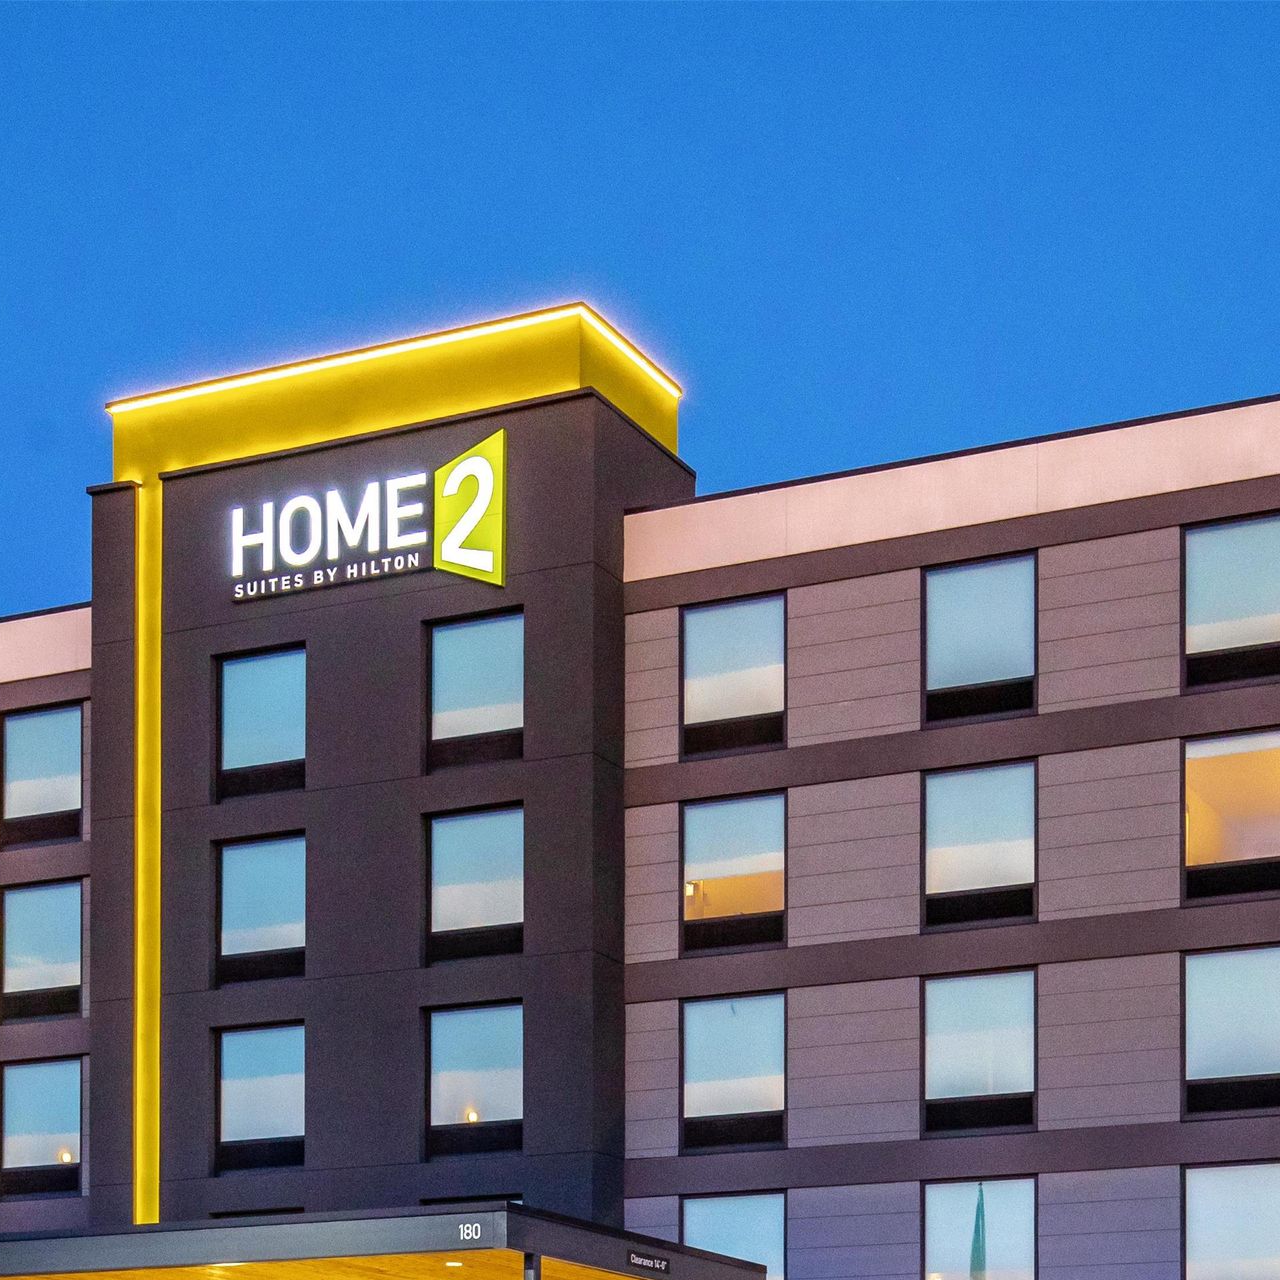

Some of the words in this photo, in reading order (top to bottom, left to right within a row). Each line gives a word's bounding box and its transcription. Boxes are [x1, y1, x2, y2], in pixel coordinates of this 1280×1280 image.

[231, 472, 427, 577] HOME
[441, 455, 495, 573] 2
[234, 573, 304, 598] SUITES
[313, 567, 338, 585] BY
[346, 552, 420, 579] HILTON
[458, 1223, 481, 1240] 180
[630, 1253, 654, 1268] Clearance
